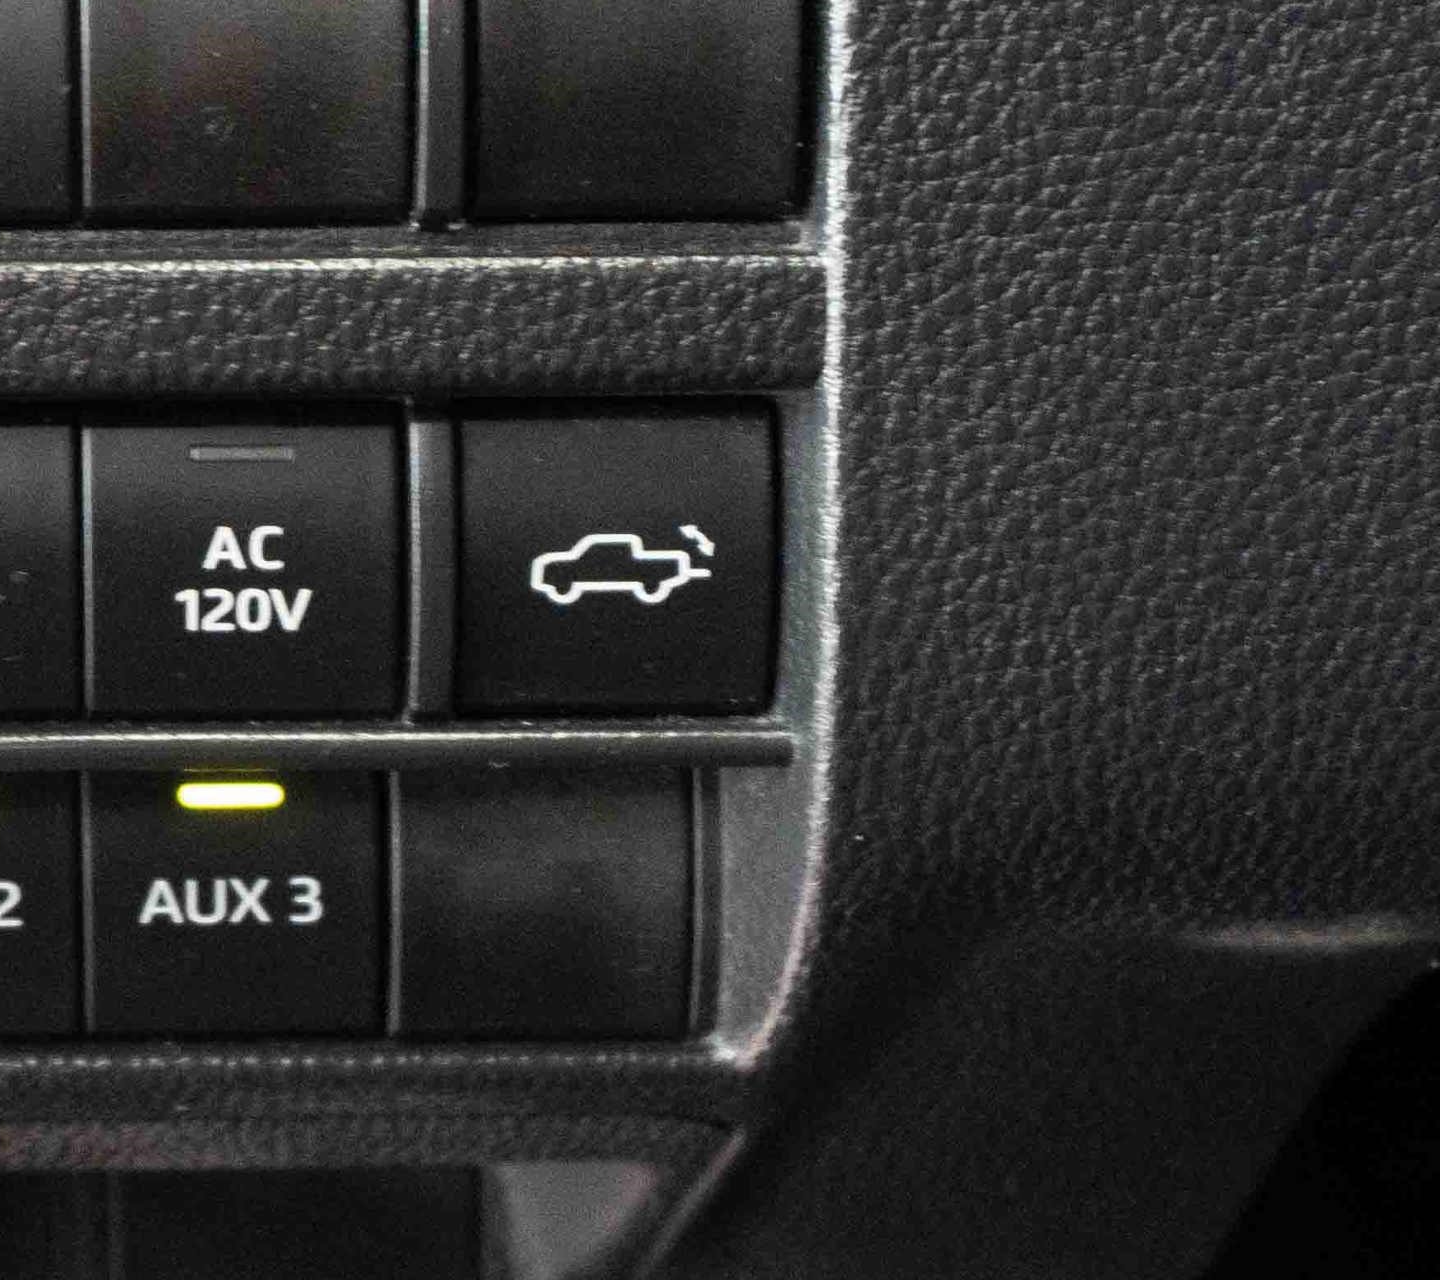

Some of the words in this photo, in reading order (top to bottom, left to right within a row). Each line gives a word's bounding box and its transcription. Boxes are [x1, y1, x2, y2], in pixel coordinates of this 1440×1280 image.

[202, 525, 285, 570] AC
[174, 588, 313, 632] 120V
[138, 878, 271, 925] AUX
[290, 876, 322, 923] 3
